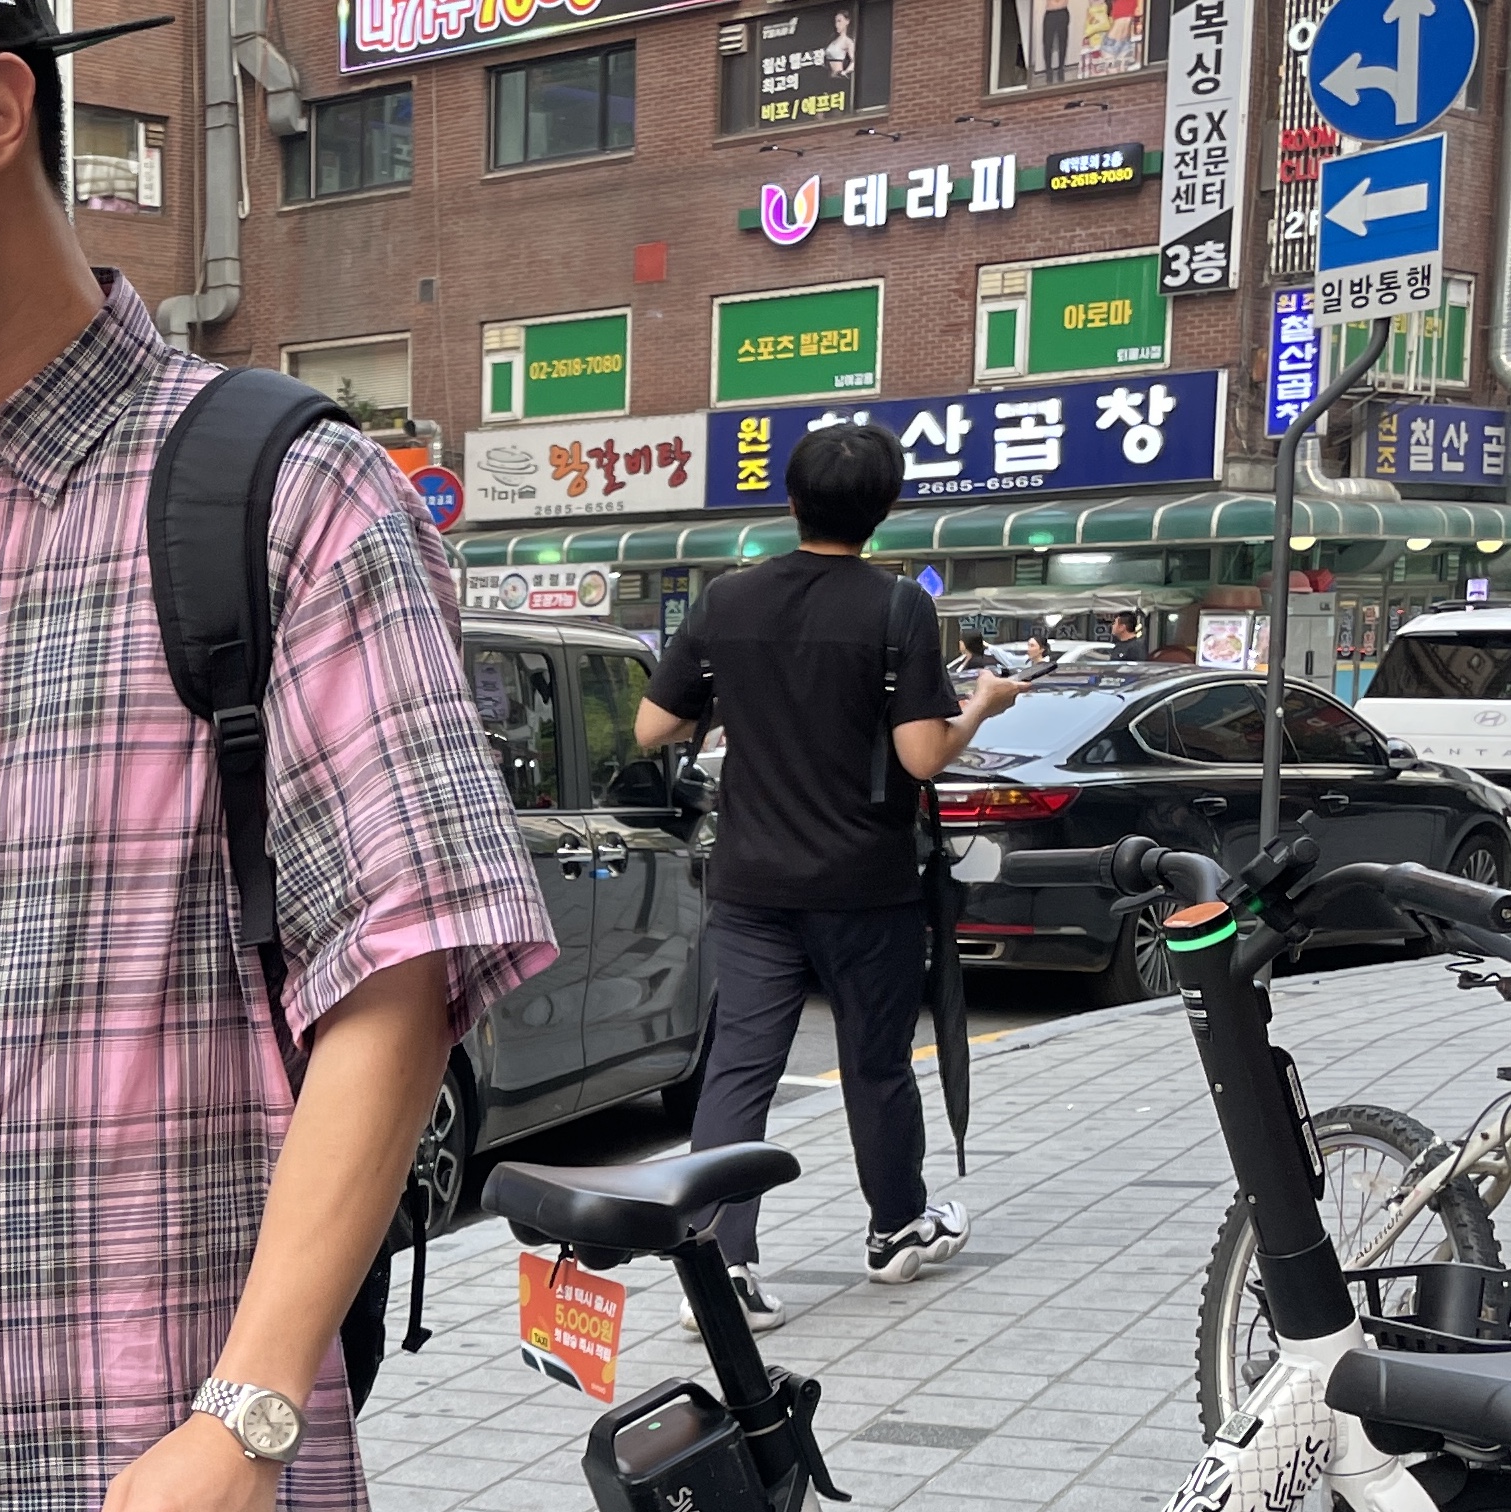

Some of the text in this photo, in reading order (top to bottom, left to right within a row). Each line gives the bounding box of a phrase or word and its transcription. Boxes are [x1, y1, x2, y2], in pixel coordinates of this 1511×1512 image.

[1187, 1, 1228, 95] 복싱
[761, 101, 790, 122] 비포
[1175, 109, 1229, 146] GX
[1174, 147, 1229, 181] 전문
[1280, 154, 1333, 183] CLU
[843, 154, 1018, 227] 테라피
[1171, 179, 1225, 214] 센터
[1163, 240, 1227, 288] 3층
[1321, 264, 1432, 315] 일방통행
[1063, 299, 1133, 330] 아로마
[737, 328, 859, 363] 스포츠 발관리
[529, 353, 623, 380] 02-2618-7080
[808, 384, 1176, 481] 산곱창
[549, 436, 692, 497] 왕갈비탕
[736, 417, 771, 491] 원조
[917, 474, 1044, 495] 2685-6565
[534, 501, 625, 516] 2685-6565
[1421, 746, 1511, 756] ANTA
[1355, 1208, 1404, 1264] AUTHOR
[554, 1302, 615, 1344] 5,000원
